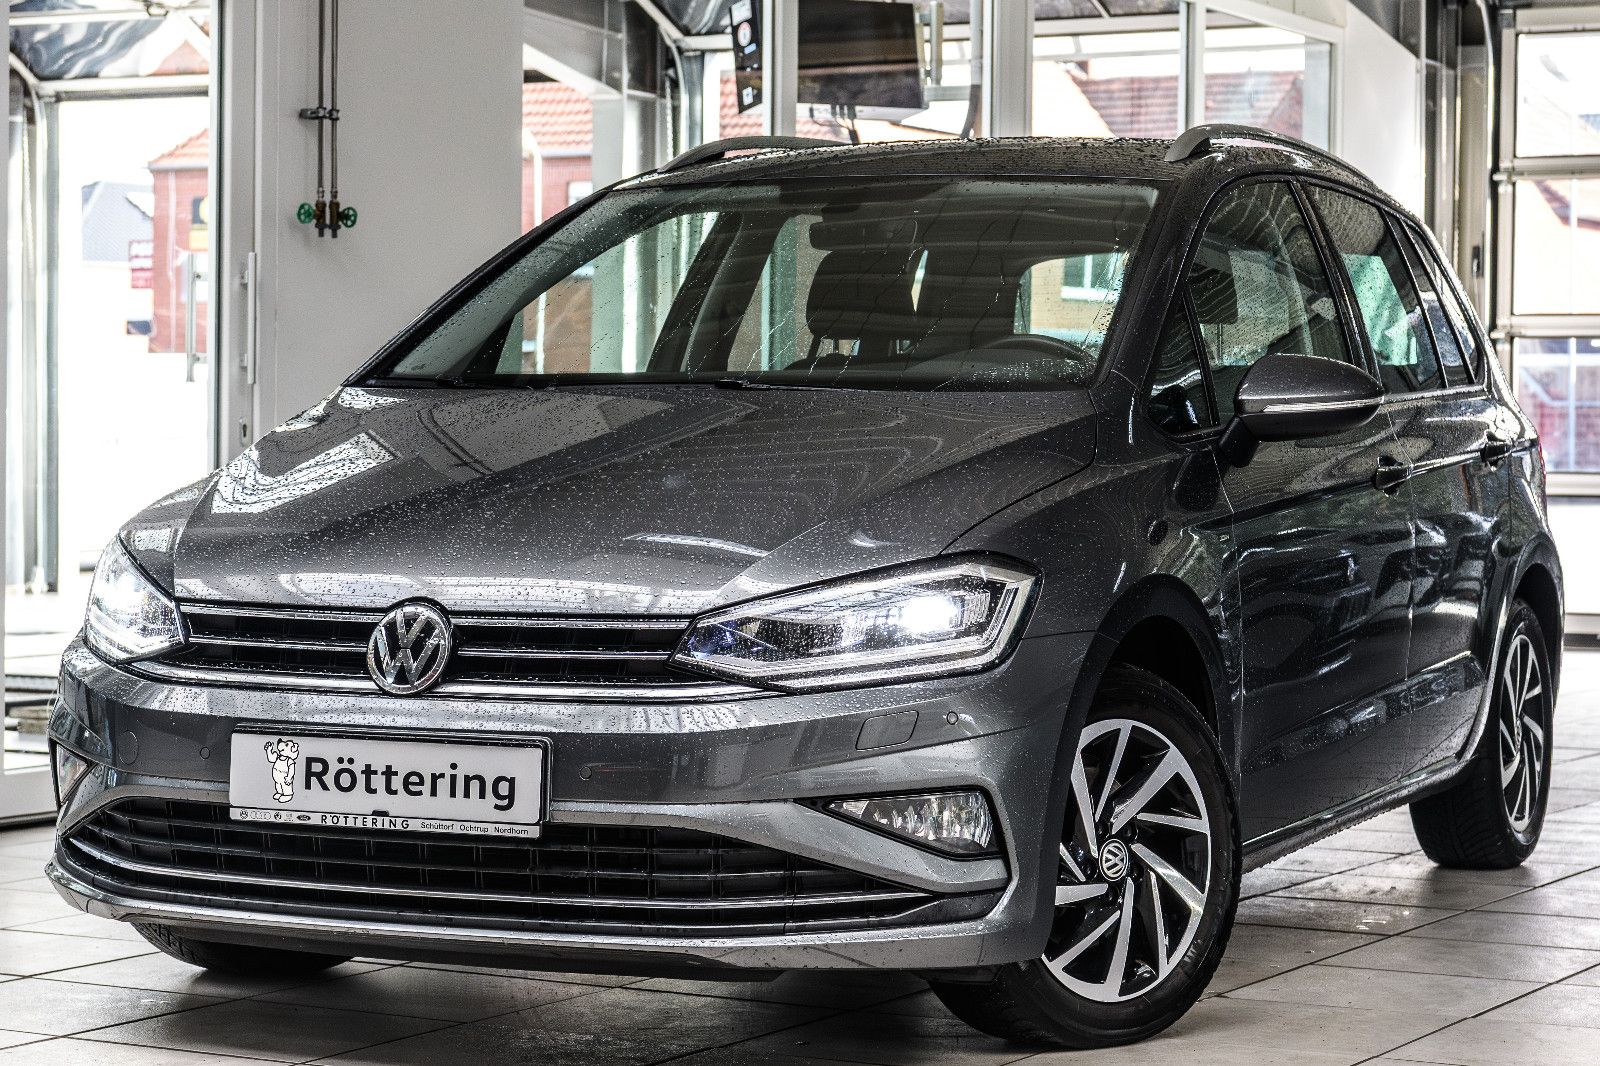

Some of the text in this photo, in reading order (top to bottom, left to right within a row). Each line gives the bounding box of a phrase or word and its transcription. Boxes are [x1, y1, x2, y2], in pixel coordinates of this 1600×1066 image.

[304, 756, 516, 811] Röttering
[321, 814, 410, 829] RÖTTERING
[459, 824, 489, 833] Ochtrup
[494, 826, 529, 835] Nordhorn
